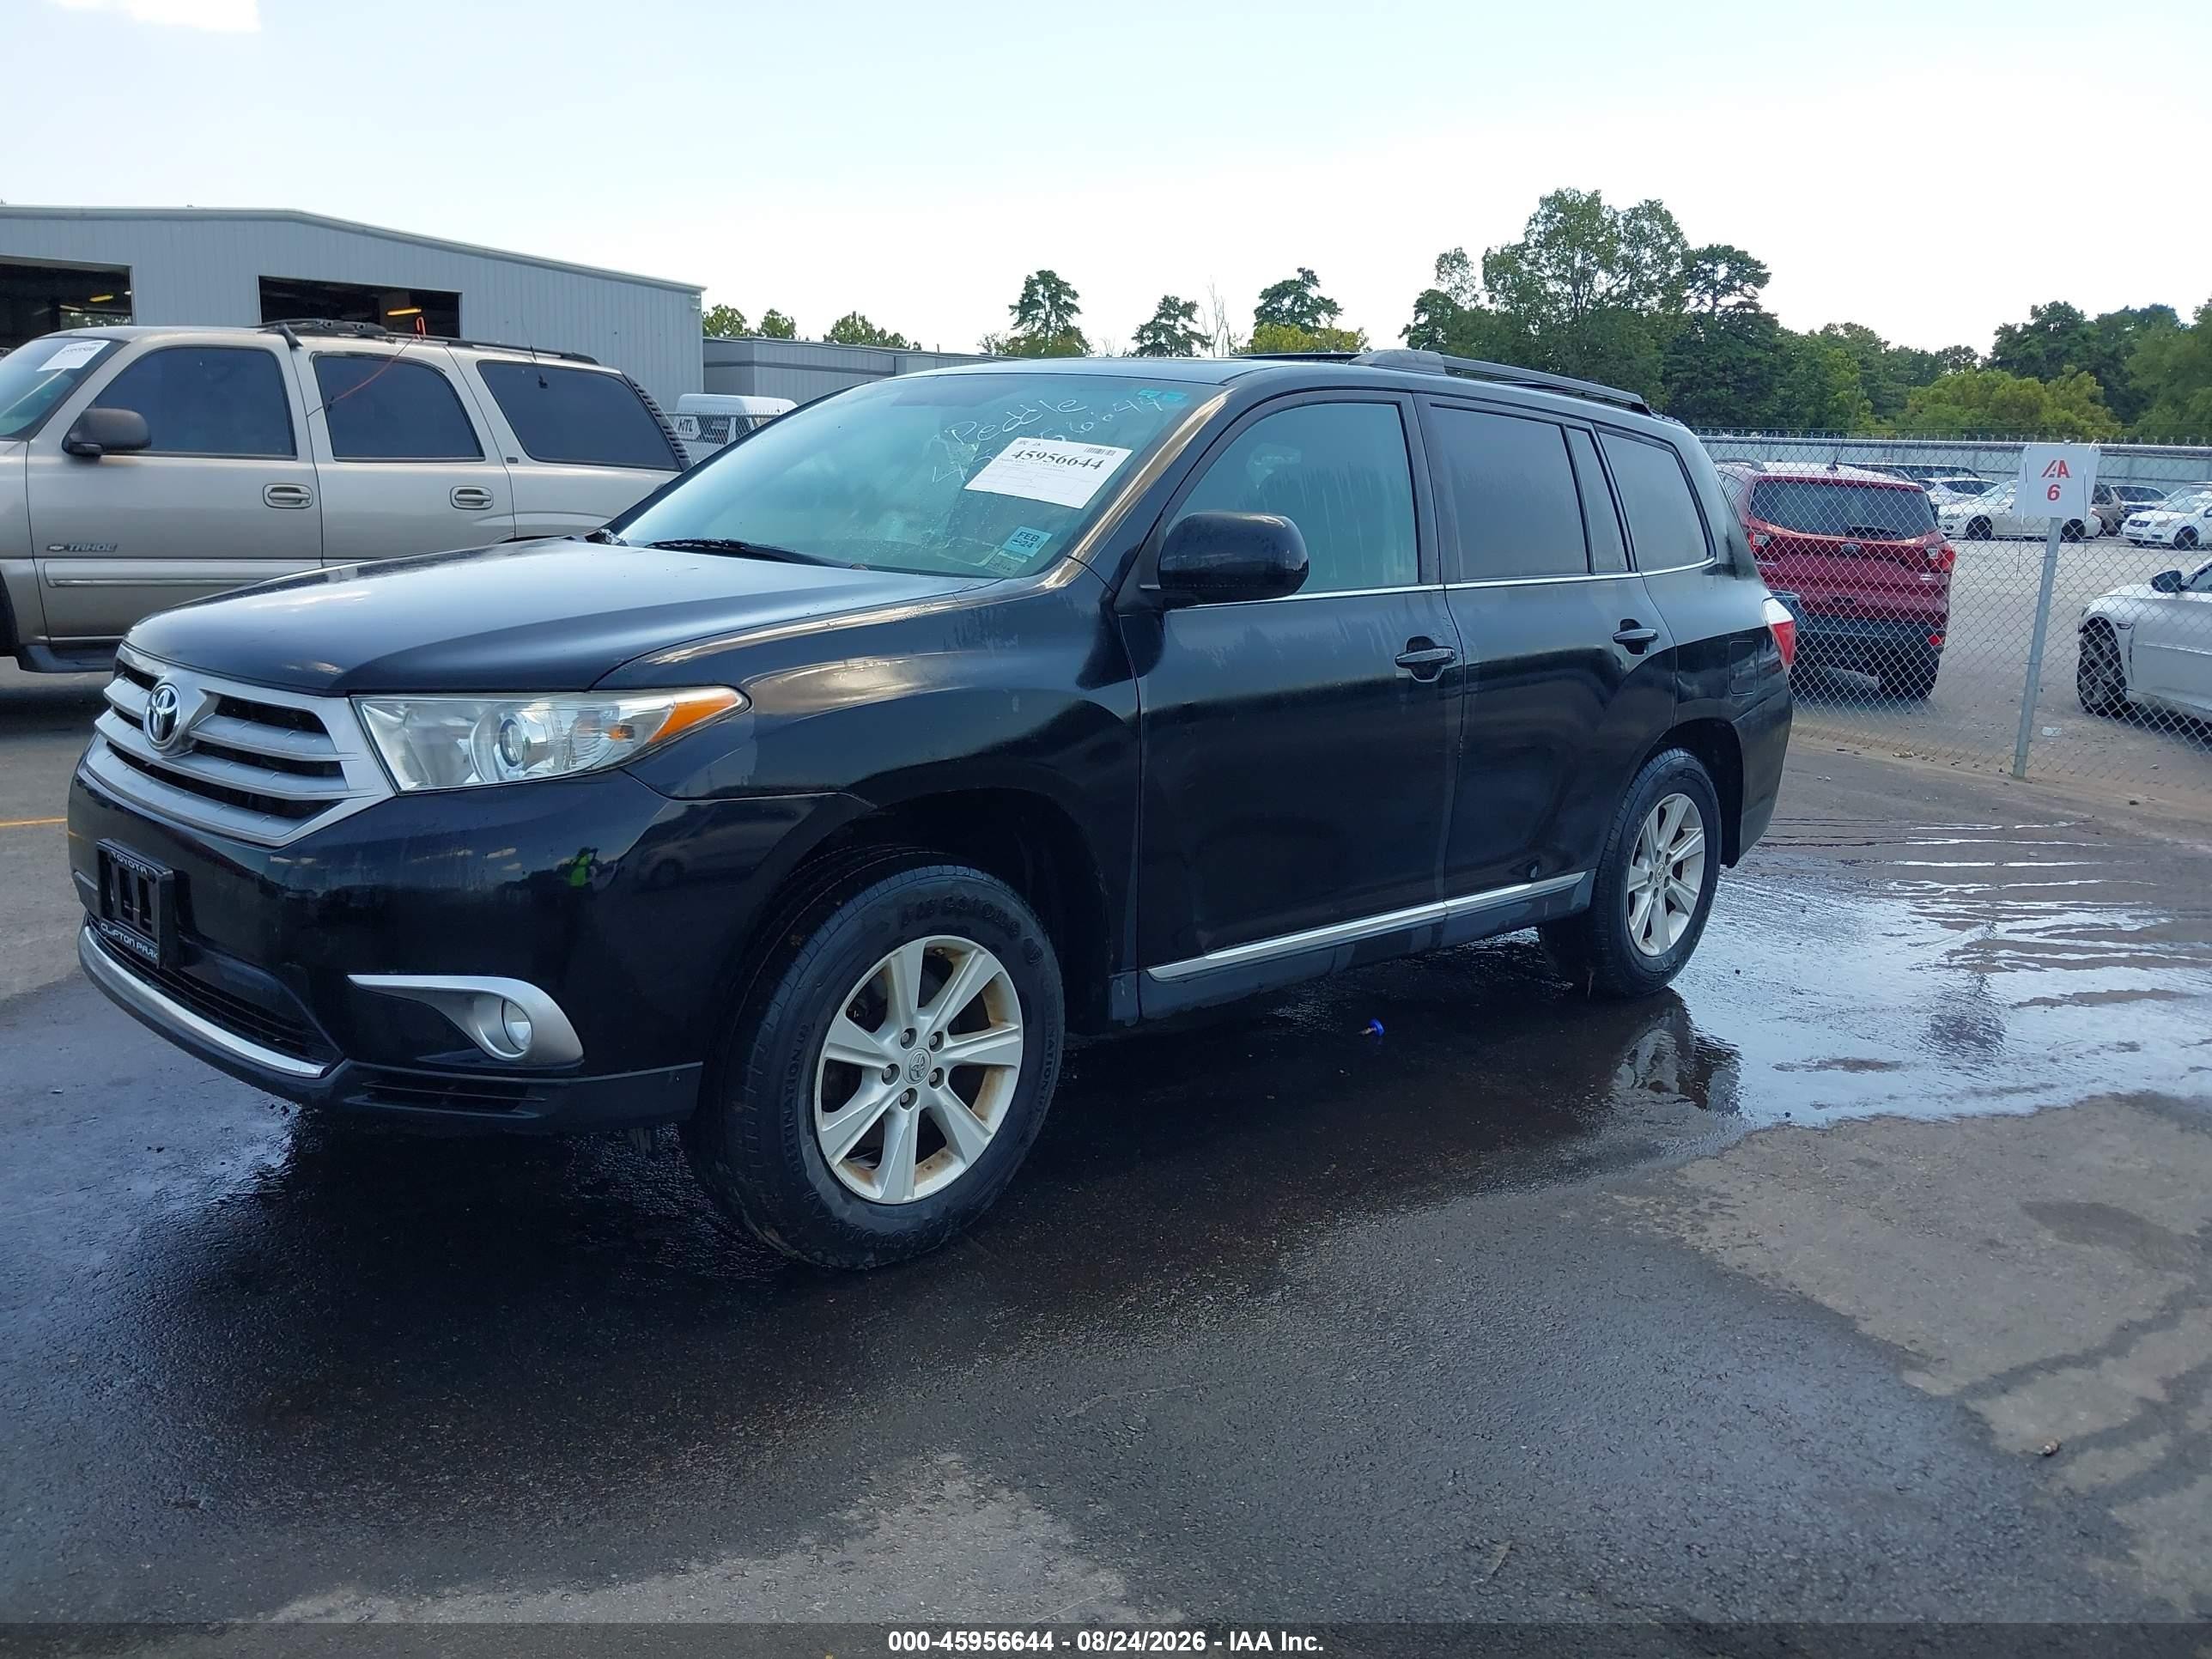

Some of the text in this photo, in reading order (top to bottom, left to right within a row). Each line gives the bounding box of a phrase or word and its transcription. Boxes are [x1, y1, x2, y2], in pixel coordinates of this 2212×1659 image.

[1011, 449, 1105, 471] 45956644
[2047, 483, 2061, 501] 6
[1017, 531, 1040, 542] FEB
[68, 543, 118, 552] TAHOE
[110, 850, 149, 875] TOYOTA
[100, 921, 159, 961] CLIFTON PARK
